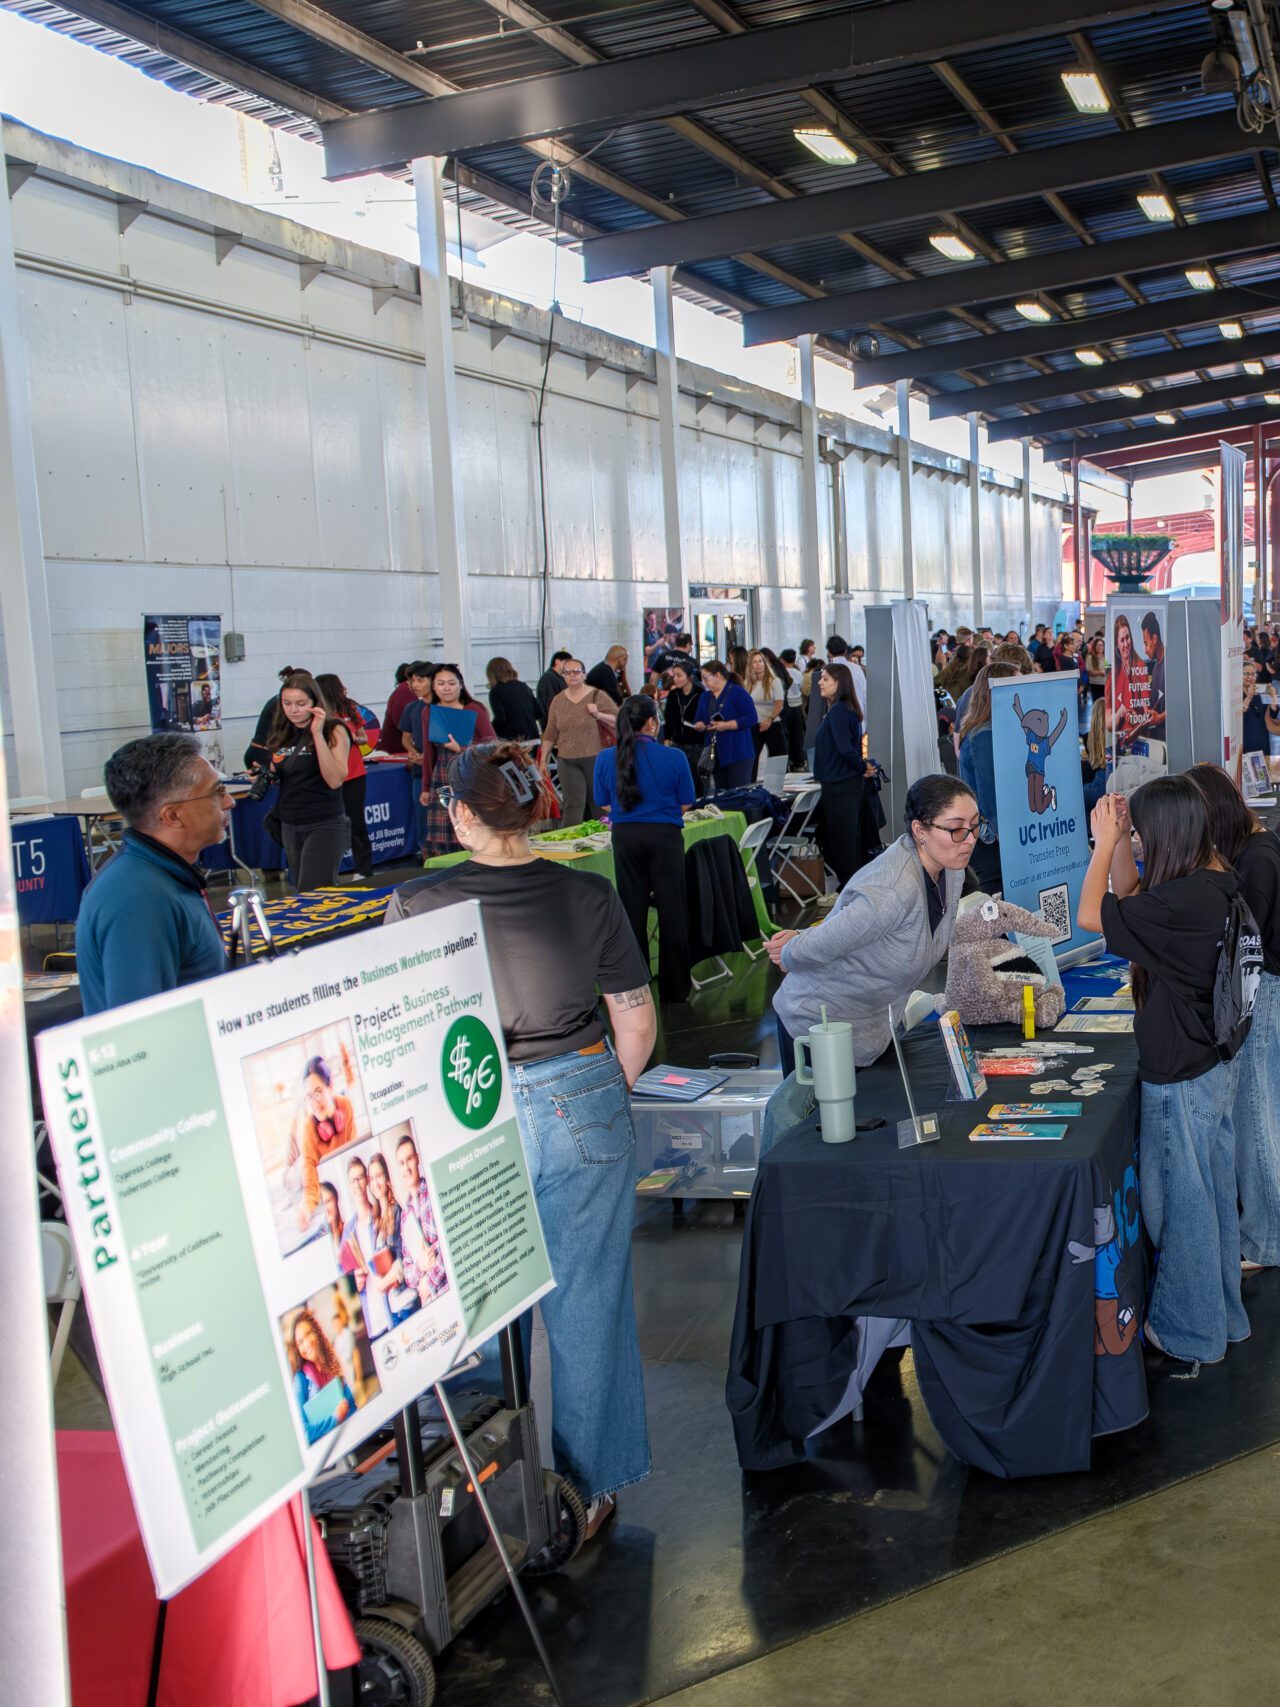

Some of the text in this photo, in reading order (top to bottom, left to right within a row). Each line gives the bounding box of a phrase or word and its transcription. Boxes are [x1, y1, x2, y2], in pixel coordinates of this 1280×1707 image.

[148, 643, 189, 655] MAJORS
[1131, 666, 1148, 676] YOUR
[1129, 683, 1151, 692] FUTURE
[1130, 698, 1150, 708] STARTS
[1130, 714, 1150, 724] TODAY
[364, 802, 390, 825] CBU
[371, 837, 405, 852] Engineering
[375, 831, 383, 840] Jill
[384, 827, 405, 838] Bourns
[1019, 817, 1076, 846] UC Irvine
[30, 838, 46, 875] 5
[1028, 845, 1070, 864] Transfer Prep
[1010, 877, 1029, 888] Contact
[1240, 935, 1261, 947] OAS
[217, 932, 479, 1037] How are students filling the Business Workforce pipeline?
[354, 985, 450, 1032] Project: Business
[358, 990, 483, 1052] Management Pathway
[361, 1040, 415, 1072] Program
[369, 1080, 404, 1102] Occupation:
[381, 1094, 405, 1112] Creative
[405, 1082, 429, 1099] Director
[108, 1108, 217, 1164] Community College
[57, 1056, 119, 1273] Partners
[115, 1152, 171, 1183] Cypress College
[448, 1135, 505, 1174] Project Overview
[119, 1166, 179, 1198] Fullerton College
[441, 1162, 516, 1210] generation and underrepresented
[493, 1193, 502, 1203] and
[502, 1188, 510, 1199] job
[444, 1206, 464, 1221] students
[464, 1201, 471, 1211] by
[471, 1188, 494, 1204] improving
[178, 1247, 186, 1258] of
[174, 1419, 215, 1455] Project
[190, 1440, 213, 1460] Career
[194, 1445, 229, 1473] Mentoring
[198, 1434, 265, 1486] Pathway Completion
[201, 1469, 239, 1499] Internships
